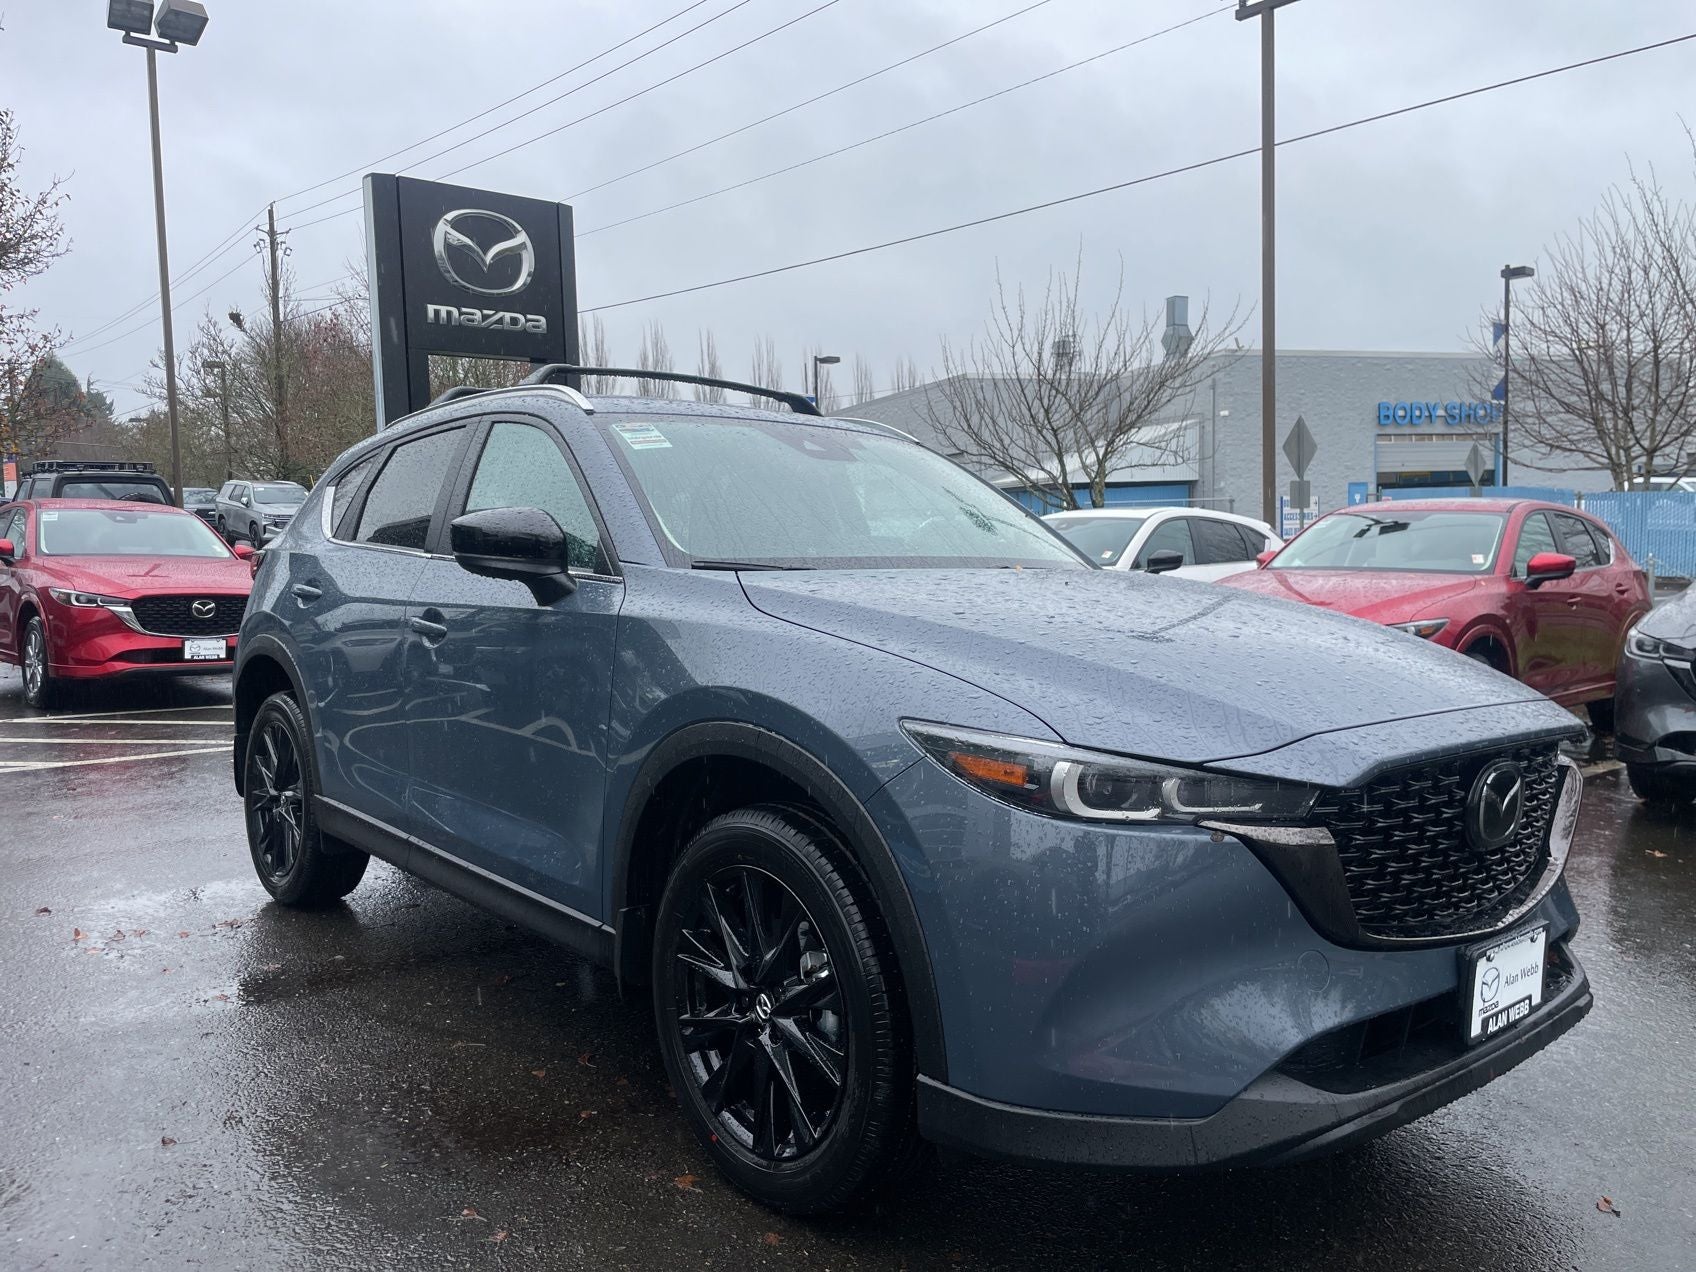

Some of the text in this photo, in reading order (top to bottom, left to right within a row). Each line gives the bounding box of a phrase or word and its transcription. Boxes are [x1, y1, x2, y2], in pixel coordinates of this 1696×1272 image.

[427, 304, 547, 334] mazda
[1378, 401, 1440, 426] BODY
[1504, 962, 1539, 987] Alan Webb
[1487, 999, 1530, 1034] ALAN WEBB
